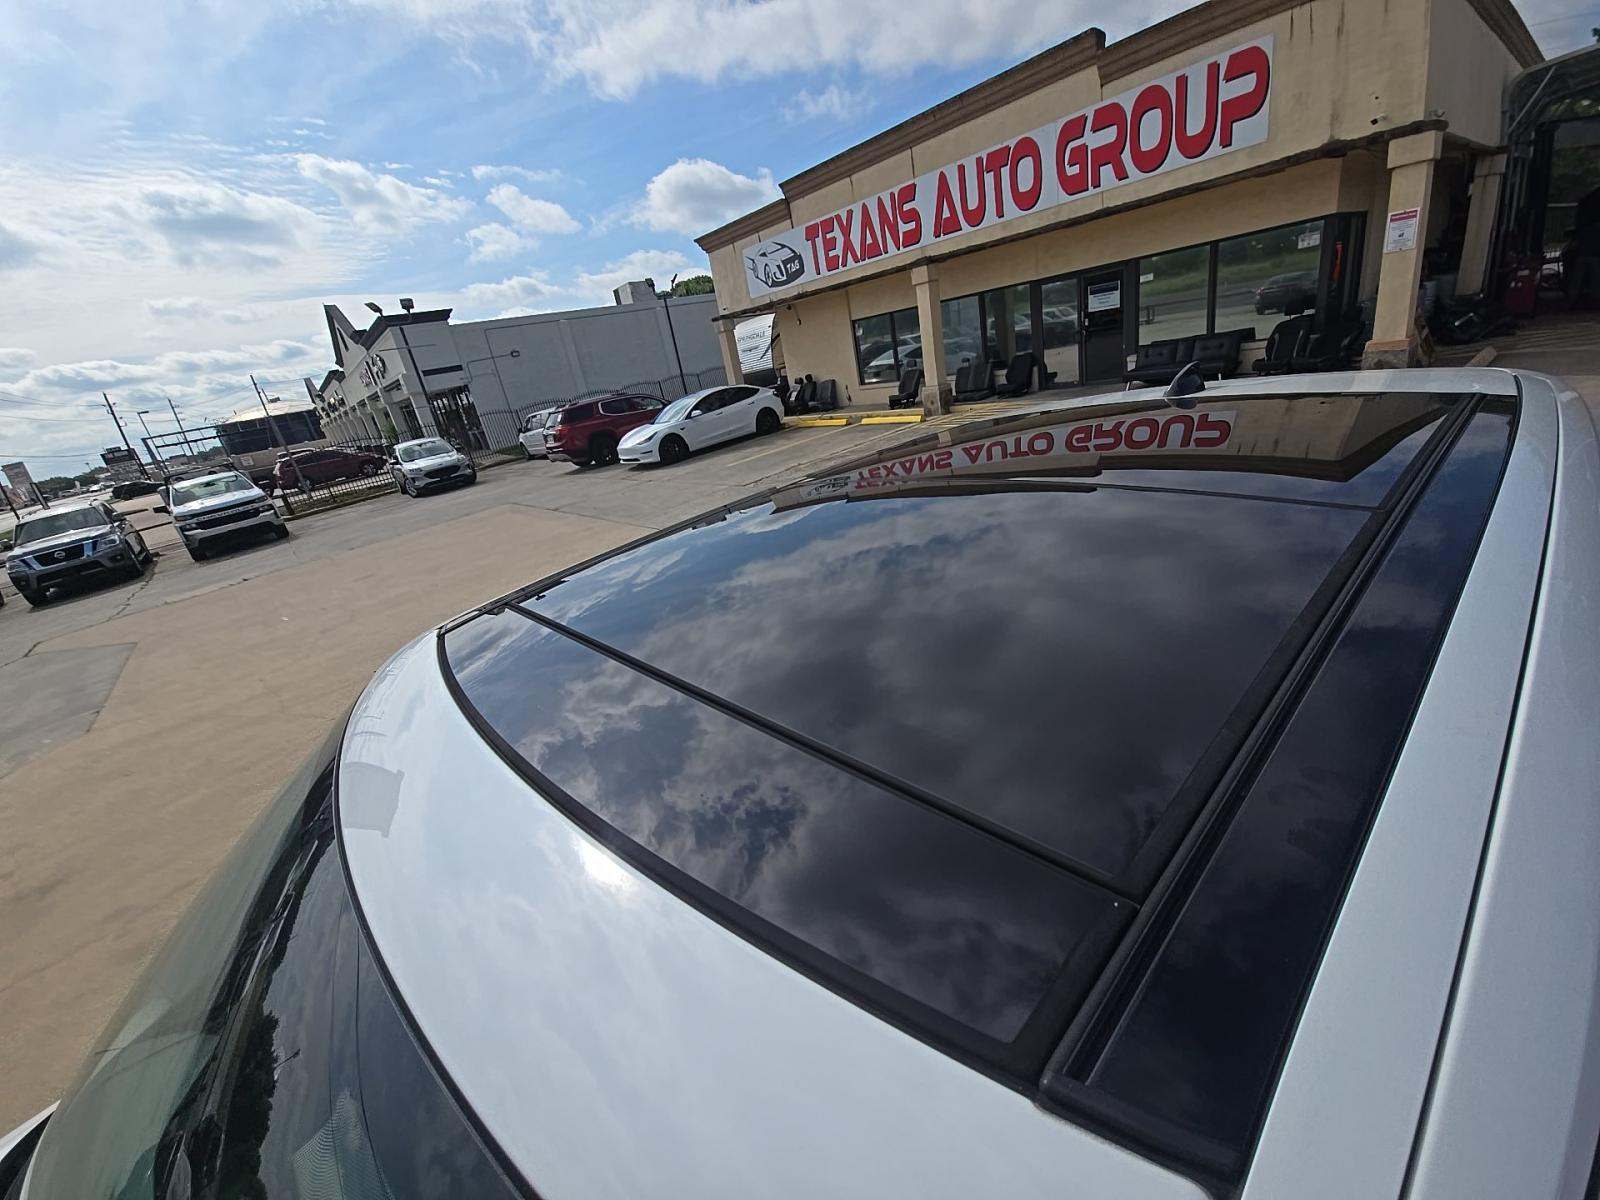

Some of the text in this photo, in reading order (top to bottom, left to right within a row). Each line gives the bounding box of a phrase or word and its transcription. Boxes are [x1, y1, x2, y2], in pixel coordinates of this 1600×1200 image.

[804, 45, 1270, 276] TEXANS AUTO GROUP
[786, 260, 800, 273] TAG
[197, 502, 259, 521] CHEVRO
